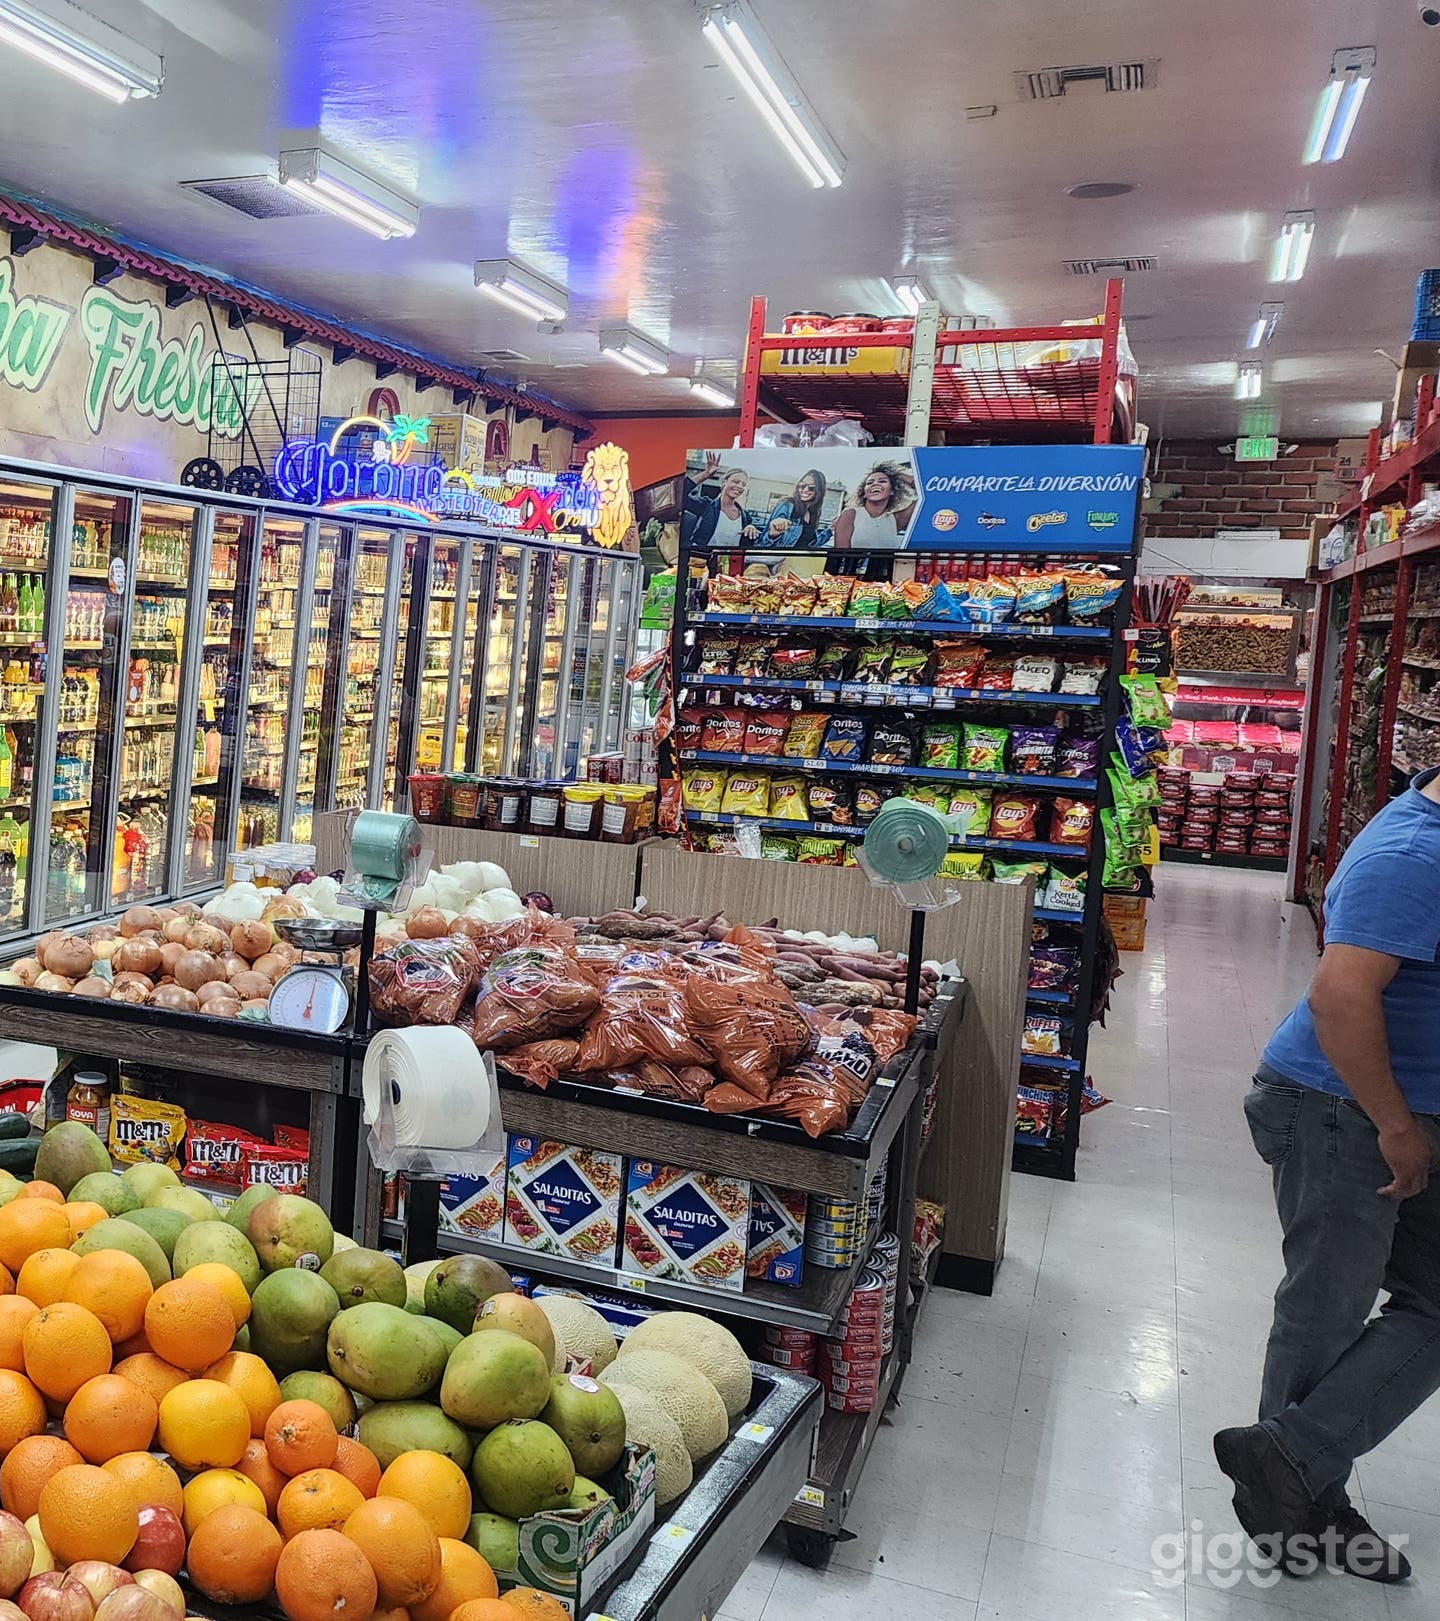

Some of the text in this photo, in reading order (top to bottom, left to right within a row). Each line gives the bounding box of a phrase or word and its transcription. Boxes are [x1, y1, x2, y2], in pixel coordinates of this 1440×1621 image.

[1340, 457, 1351, 465] 24
[275, 440, 446, 507] Corona
[926, 473, 1137, 492] COMPARTE LA DIVERSIÓN
[977, 517, 1006, 525] Doritos
[1027, 511, 1068, 533] Cheetos
[853, 588, 883, 600] Cheeto
[1068, 586, 1105, 600] Cheetos
[706, 718, 741, 729] Doritos
[747, 725, 784, 736] Doritos
[1054, 891, 1079, 901] Kettle
[1050, 898, 1082, 908] Cooked
[70, 1109, 94, 1120] GOYA
[532, 1181, 592, 1205] SALADITAS
[653, 1206, 718, 1228] SALADITAS
